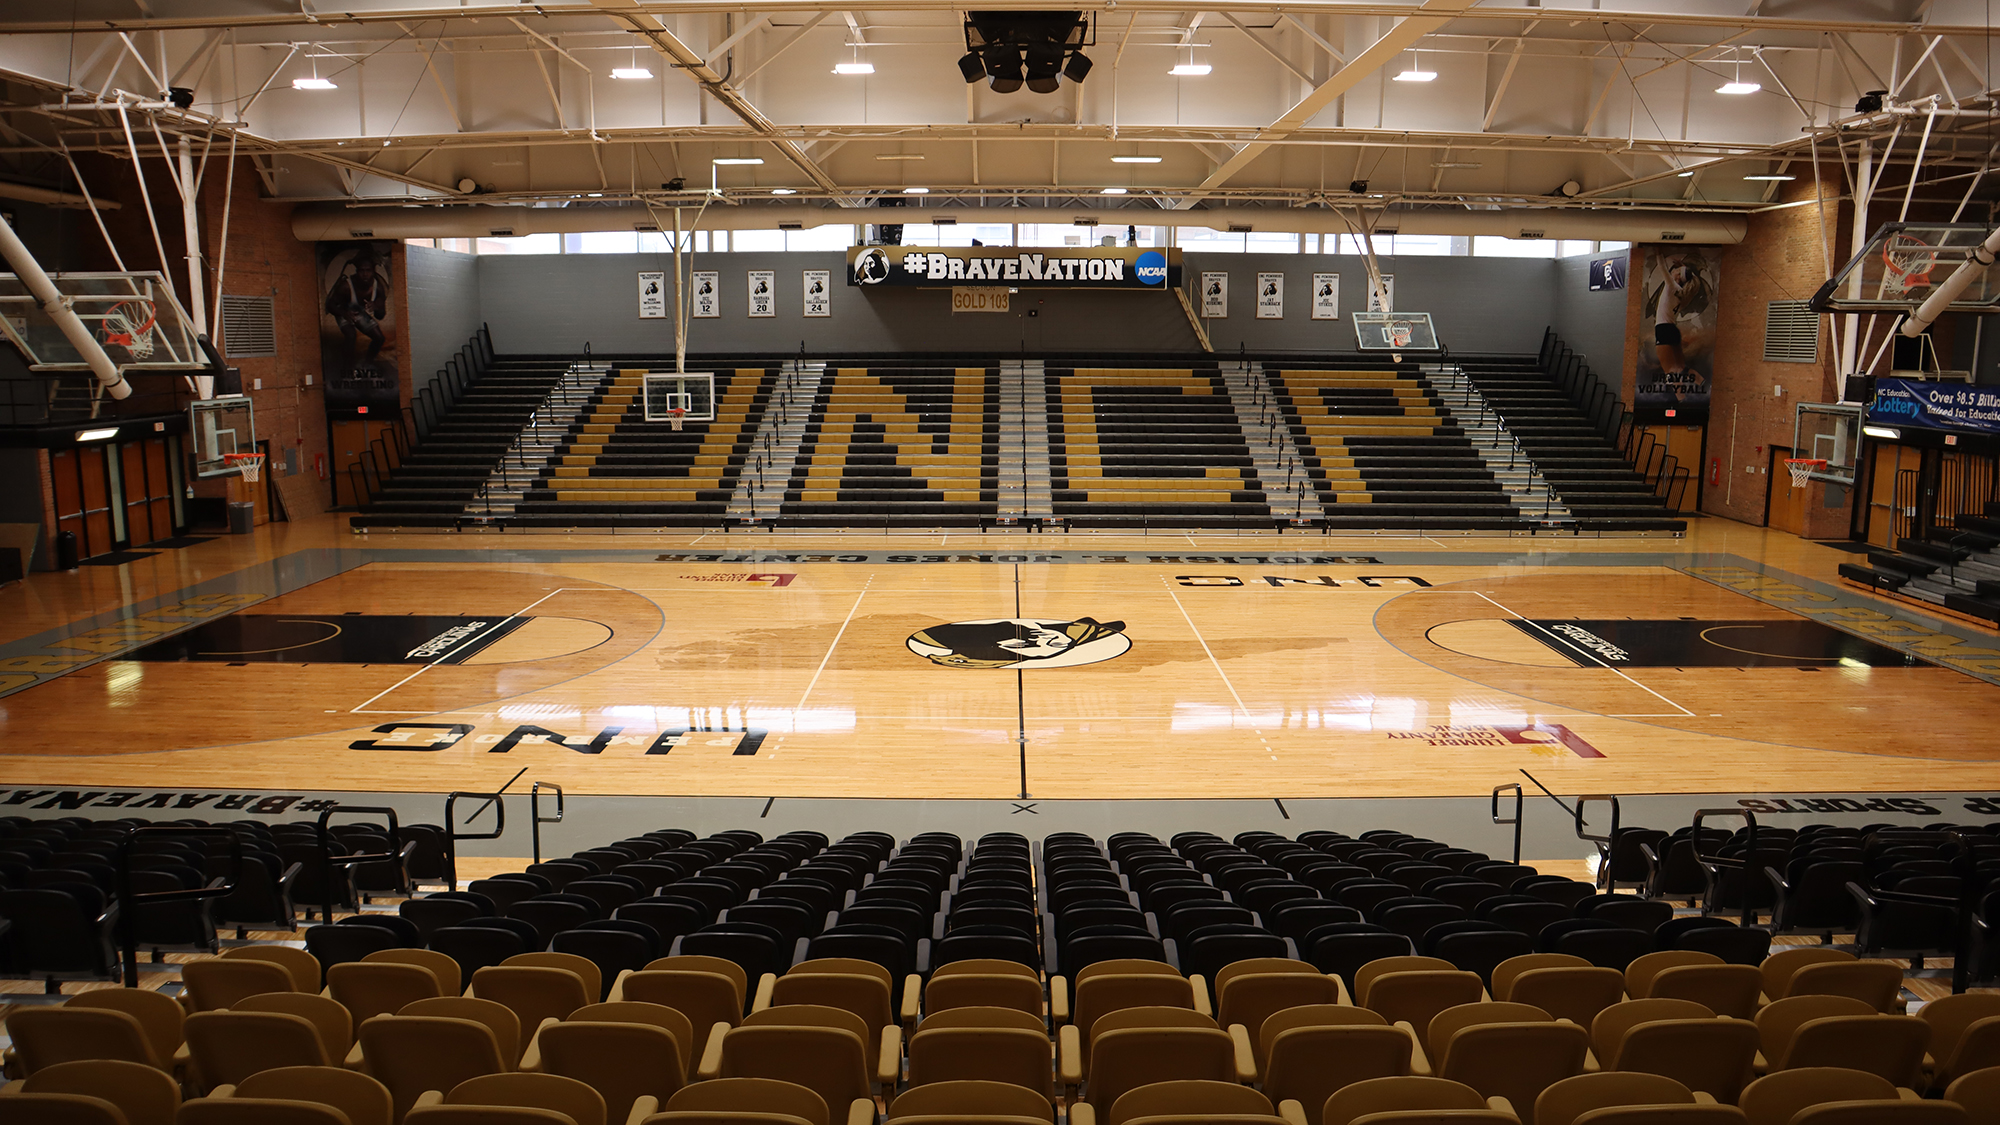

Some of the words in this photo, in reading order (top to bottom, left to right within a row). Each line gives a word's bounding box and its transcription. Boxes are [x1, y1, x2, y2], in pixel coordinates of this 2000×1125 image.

[1138, 266, 1167, 277] NCAA
[954, 292, 986, 308] GOLD
[990, 294, 1008, 308] 103
[332, 380, 394, 390] WRESTLING
[1638, 384, 1707, 394] VOLLEYBALL
[1886, 389, 1911, 398] Education
[1930, 390, 1954, 404] Over
[1957, 390, 1976, 405] $8.5
[1877, 396, 1921, 419] Lottery
[1955, 406, 1966, 418] for
[654, 552, 869, 564] CENTER
[884, 554, 1064, 565] JONES
[1080, 554, 1129, 564] E.
[1144, 555, 1382, 565] ENGLISH
[1174, 575, 1434, 588] UNC
[1429, 724, 1488, 732] BANK
[346, 723, 770, 756] UNC
[377, 732, 737, 747] PEMBROKE
[1384, 731, 1497, 740] GUARANTY
[1424, 738, 1506, 746] LUMBEE
[0, 789, 339, 815] #BRAVENA
